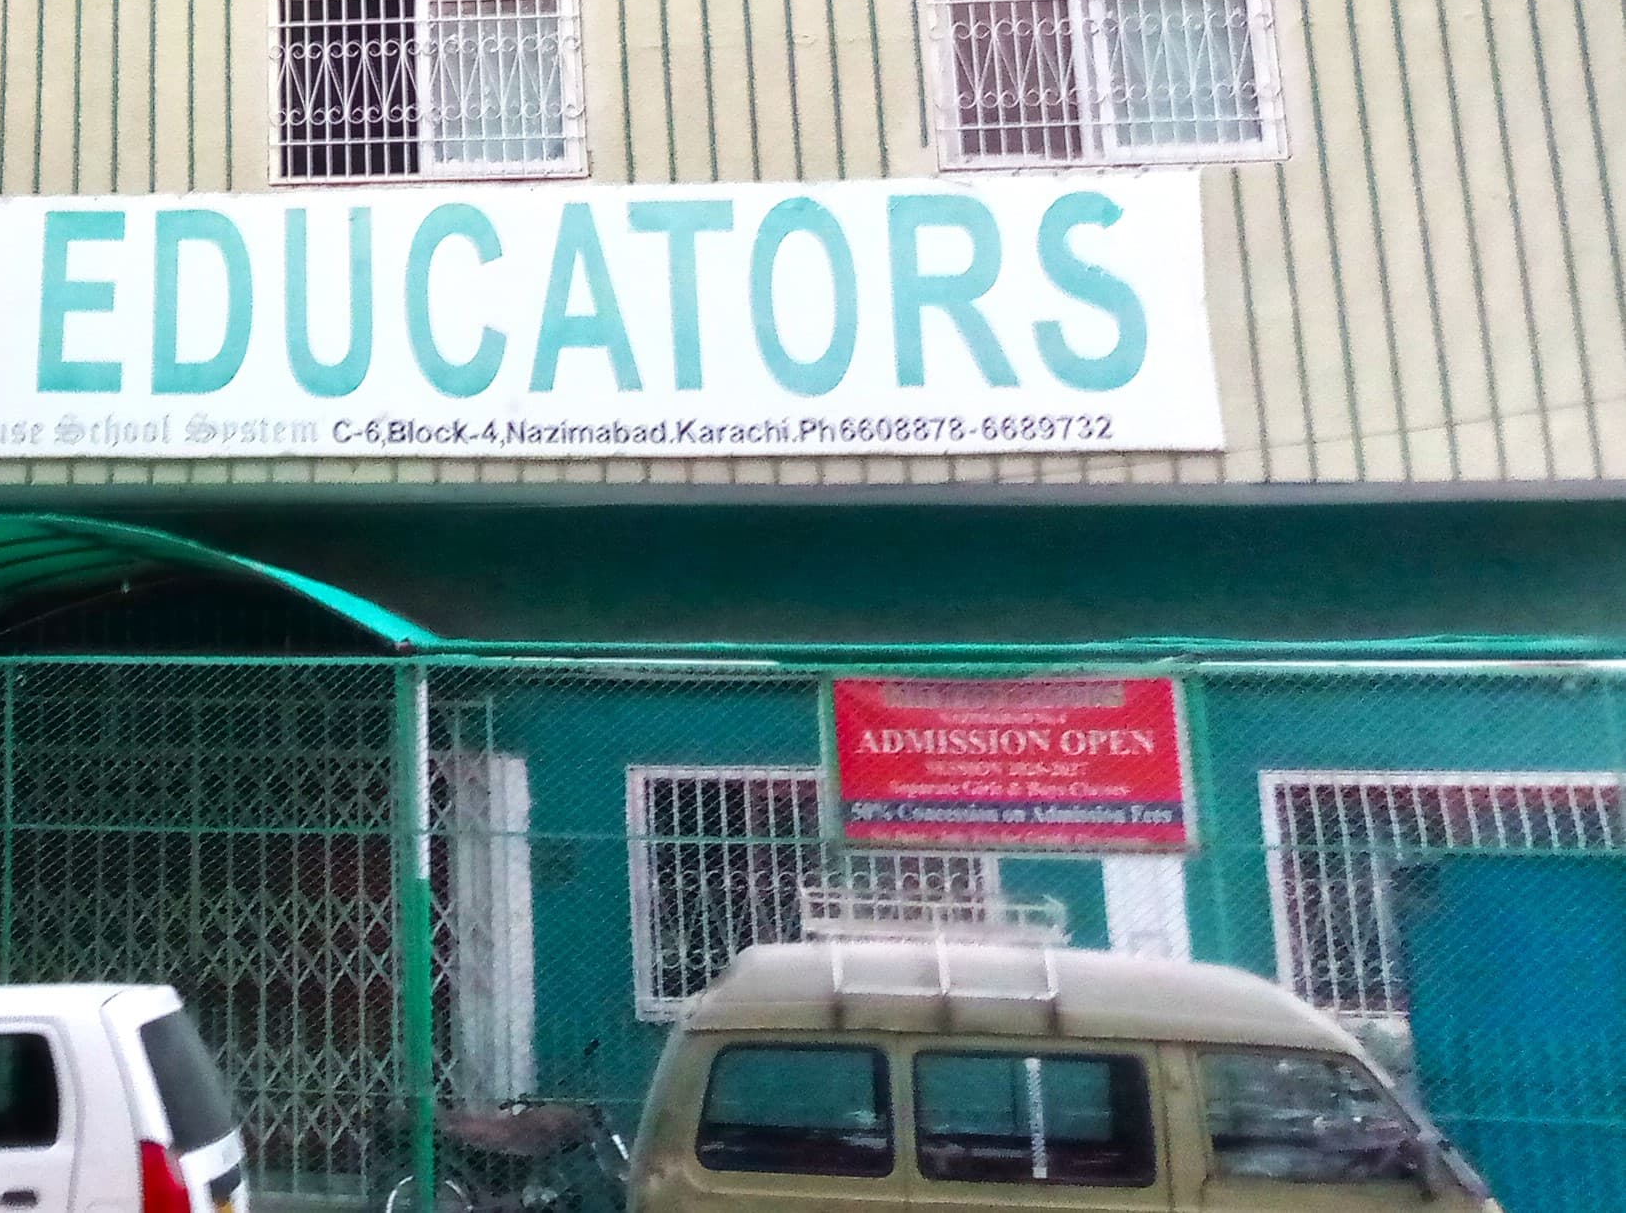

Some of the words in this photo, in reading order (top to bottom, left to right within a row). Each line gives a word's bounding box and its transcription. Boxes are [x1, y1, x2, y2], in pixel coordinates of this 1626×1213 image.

[36, 190, 1148, 399] EDUCATORS
[54, 411, 171, 449] School
[184, 411, 319, 452] System
[855, 729, 1052, 755] ADMISSION
[1059, 729, 1156, 755] OPEN
